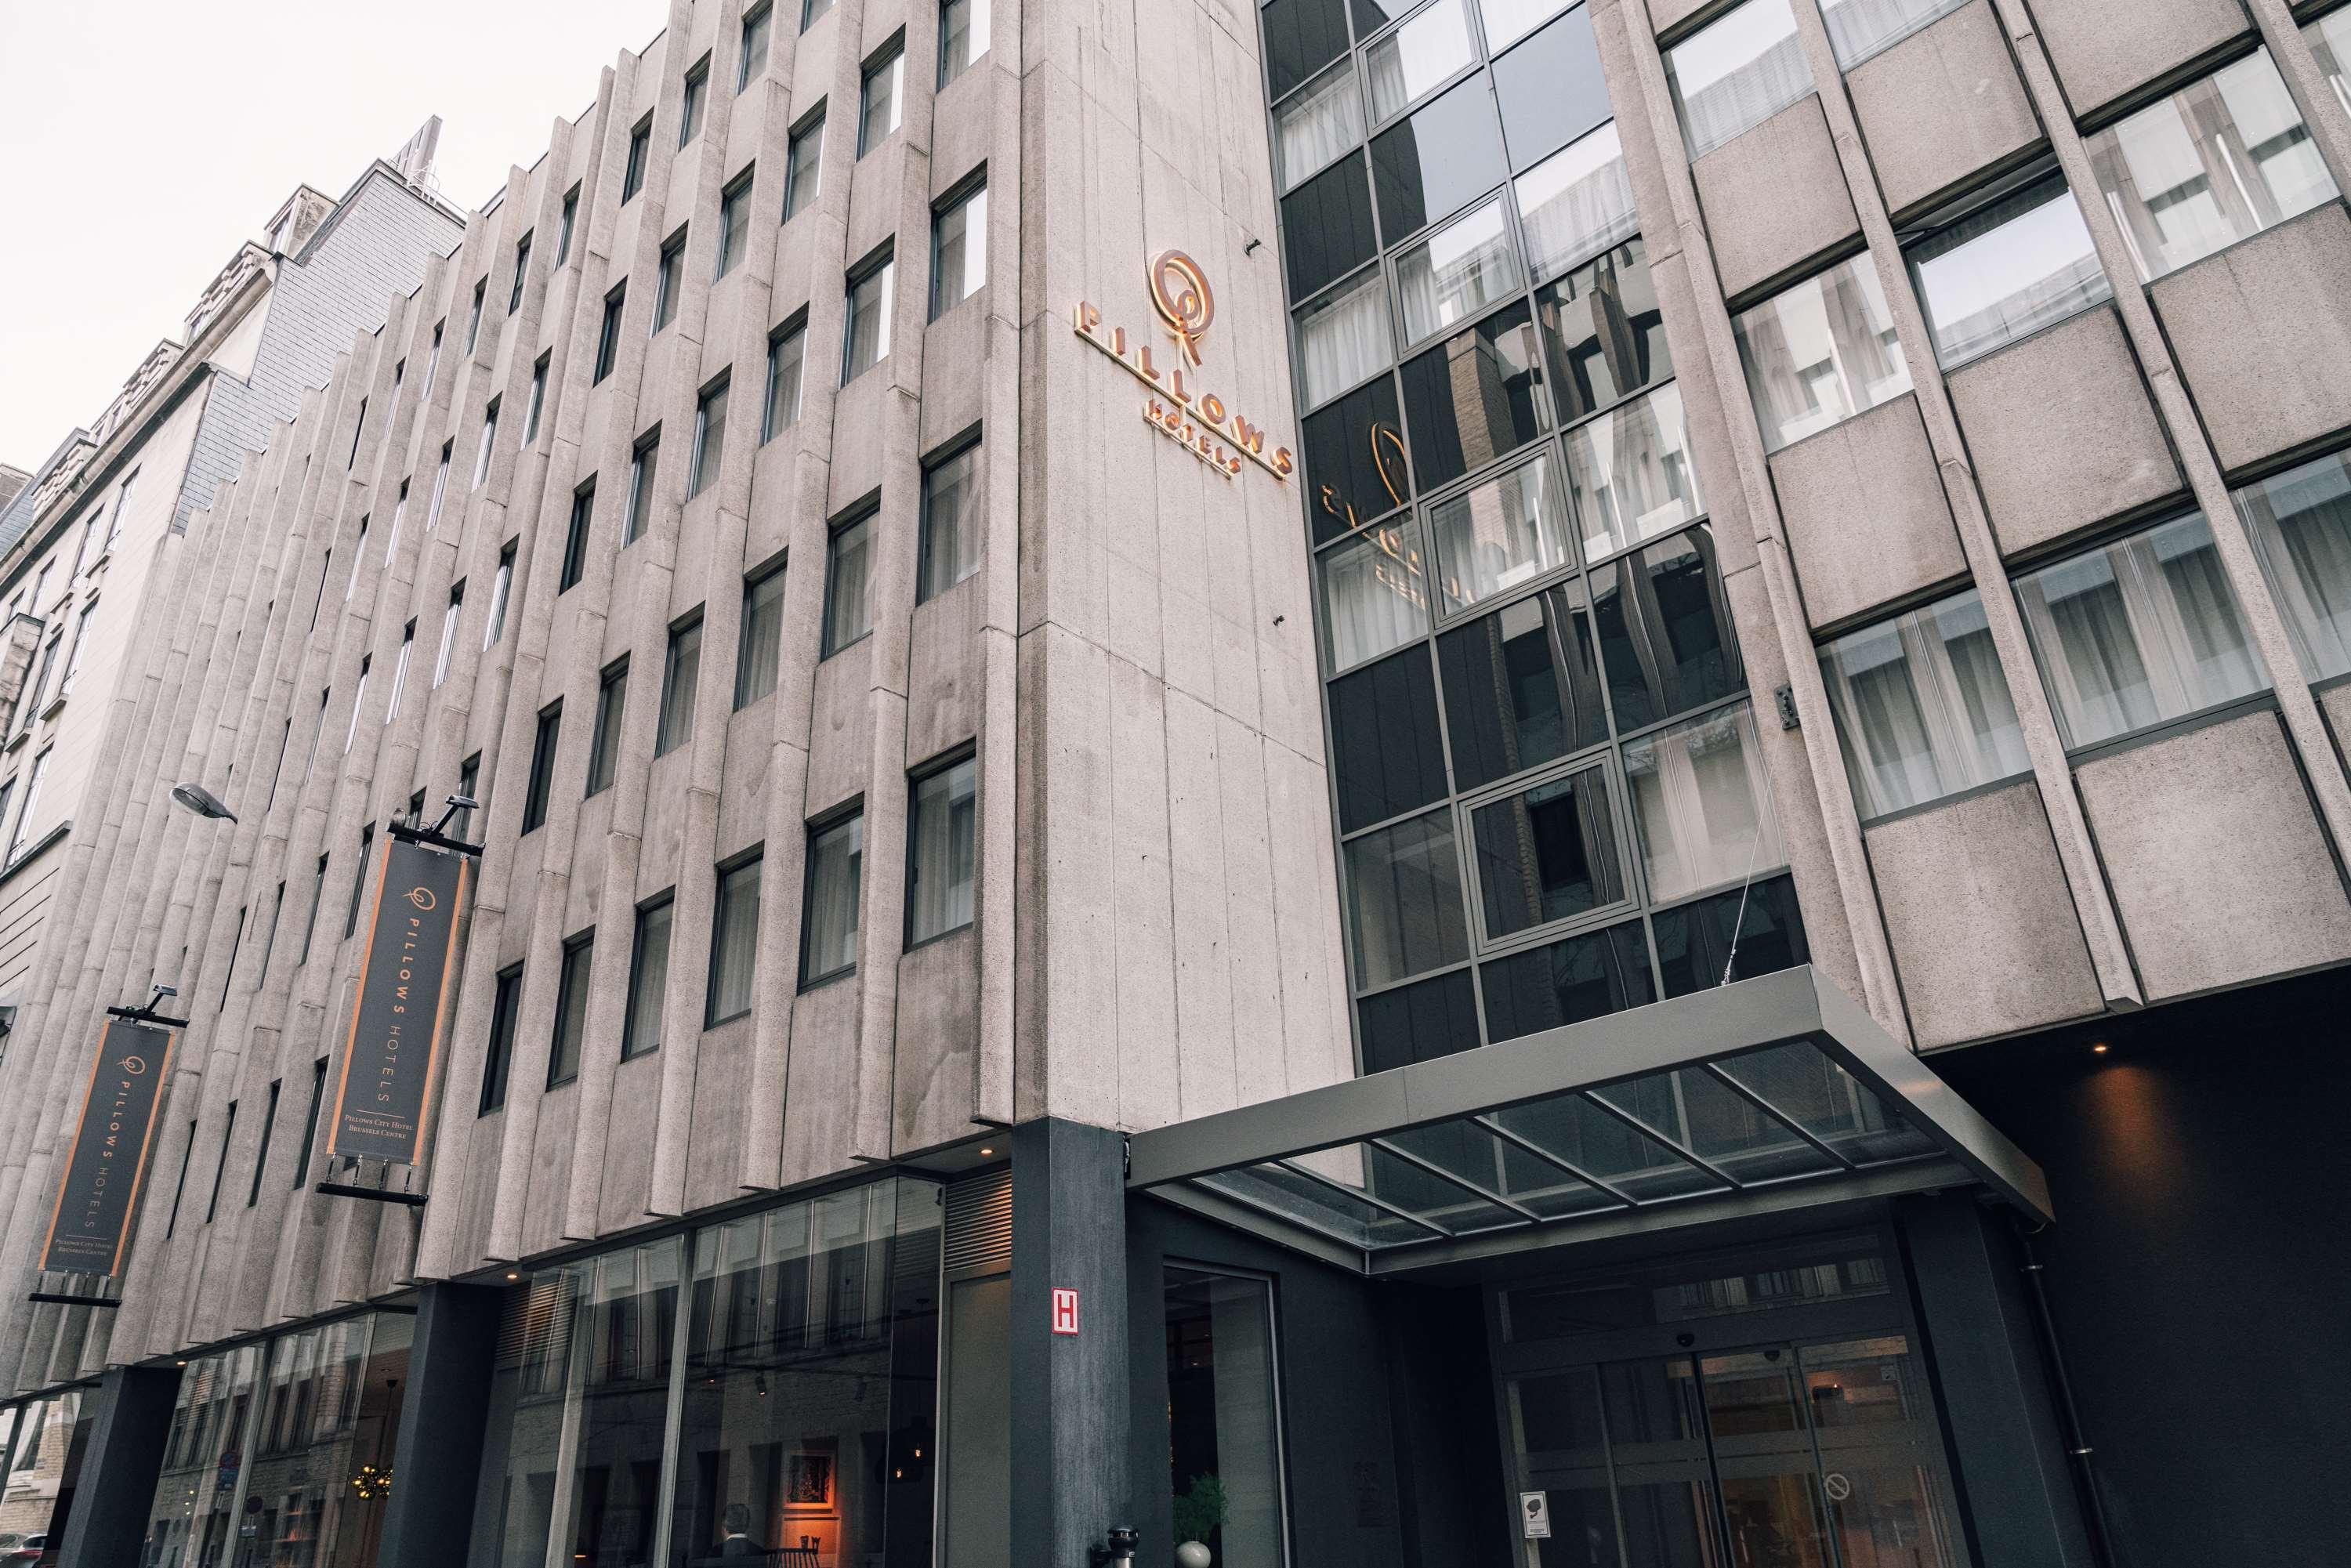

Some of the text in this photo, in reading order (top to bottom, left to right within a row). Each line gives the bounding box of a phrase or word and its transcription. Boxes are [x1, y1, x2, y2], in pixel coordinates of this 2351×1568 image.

[1074, 301, 1293, 475] PILLOWS
[1144, 398, 1241, 474] HOTELS
[378, 918, 420, 1102] PILLOWS HOTELS
[85, 1081, 130, 1229] PILLOWS HOTELS
[1057, 1294, 1074, 1328] H
